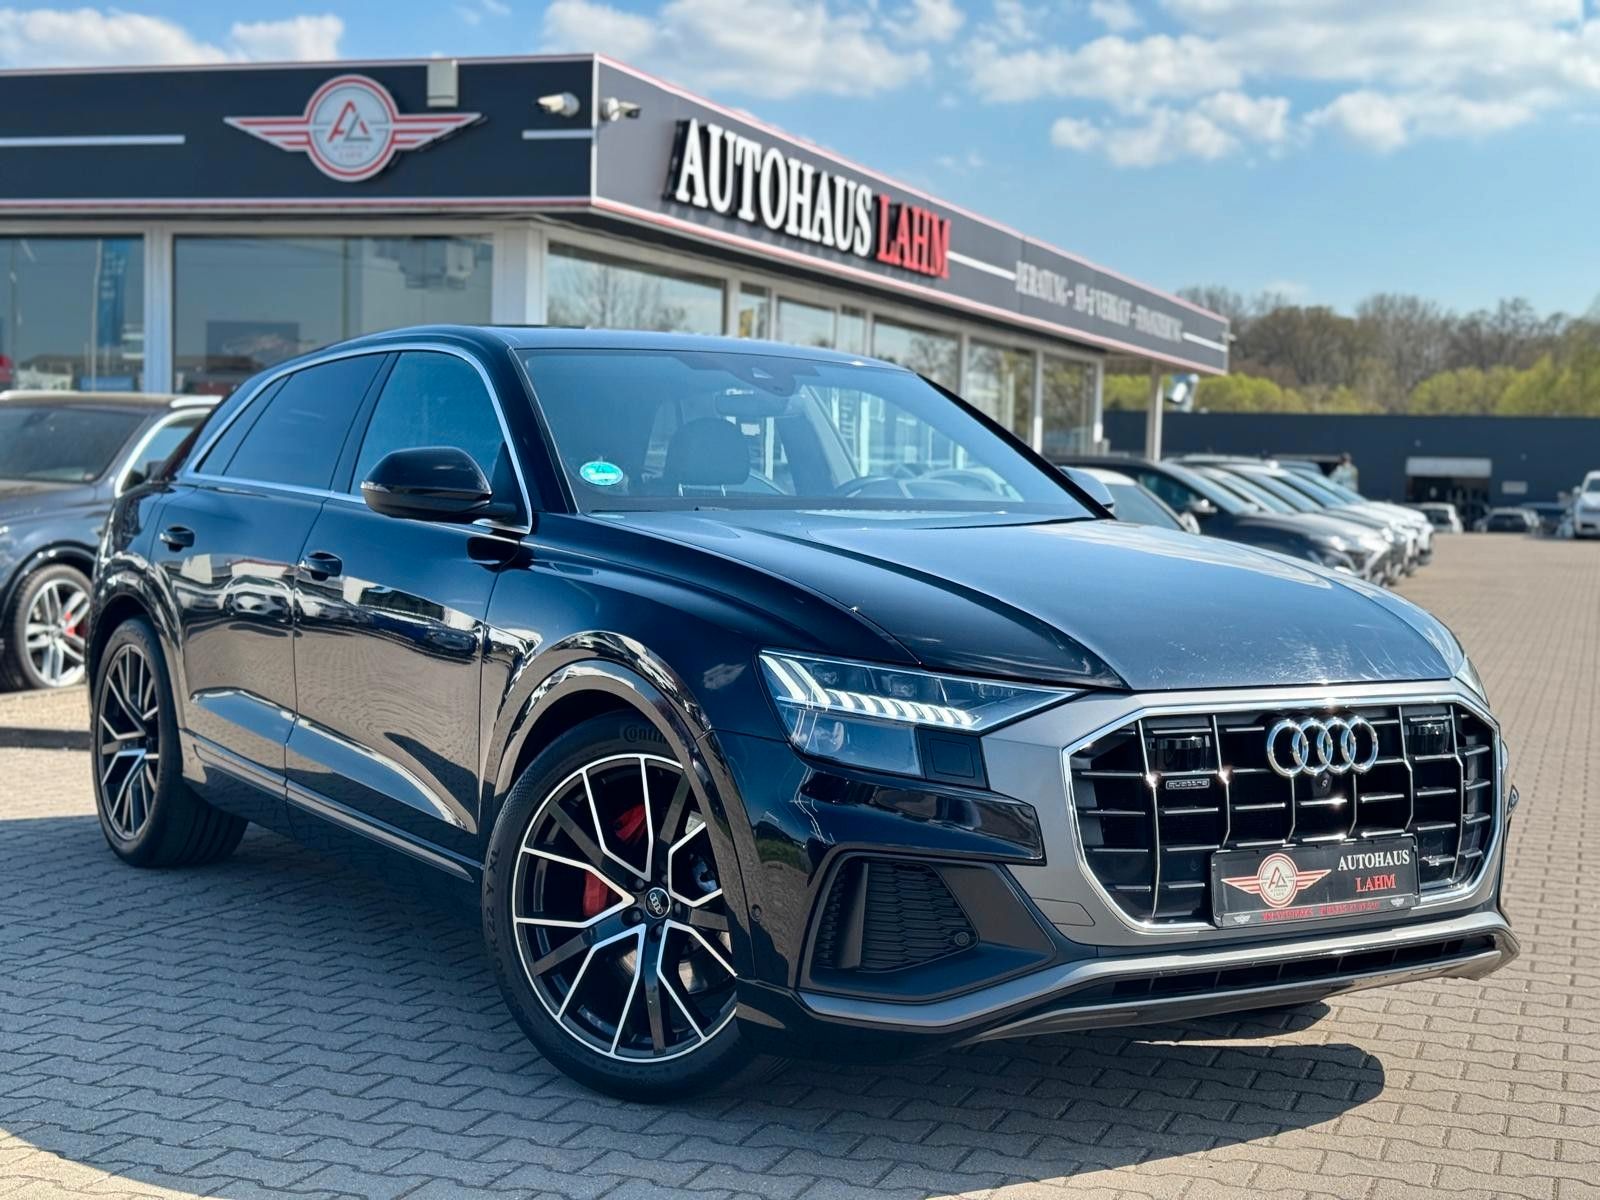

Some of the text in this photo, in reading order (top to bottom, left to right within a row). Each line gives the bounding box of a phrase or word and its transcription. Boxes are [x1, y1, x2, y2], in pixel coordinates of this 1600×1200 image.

[675, 117, 951, 279] AUTOHAUS LAHM
[1337, 849, 1410, 871] AUTOHAUS
[1355, 874, 1396, 892] LAHM
